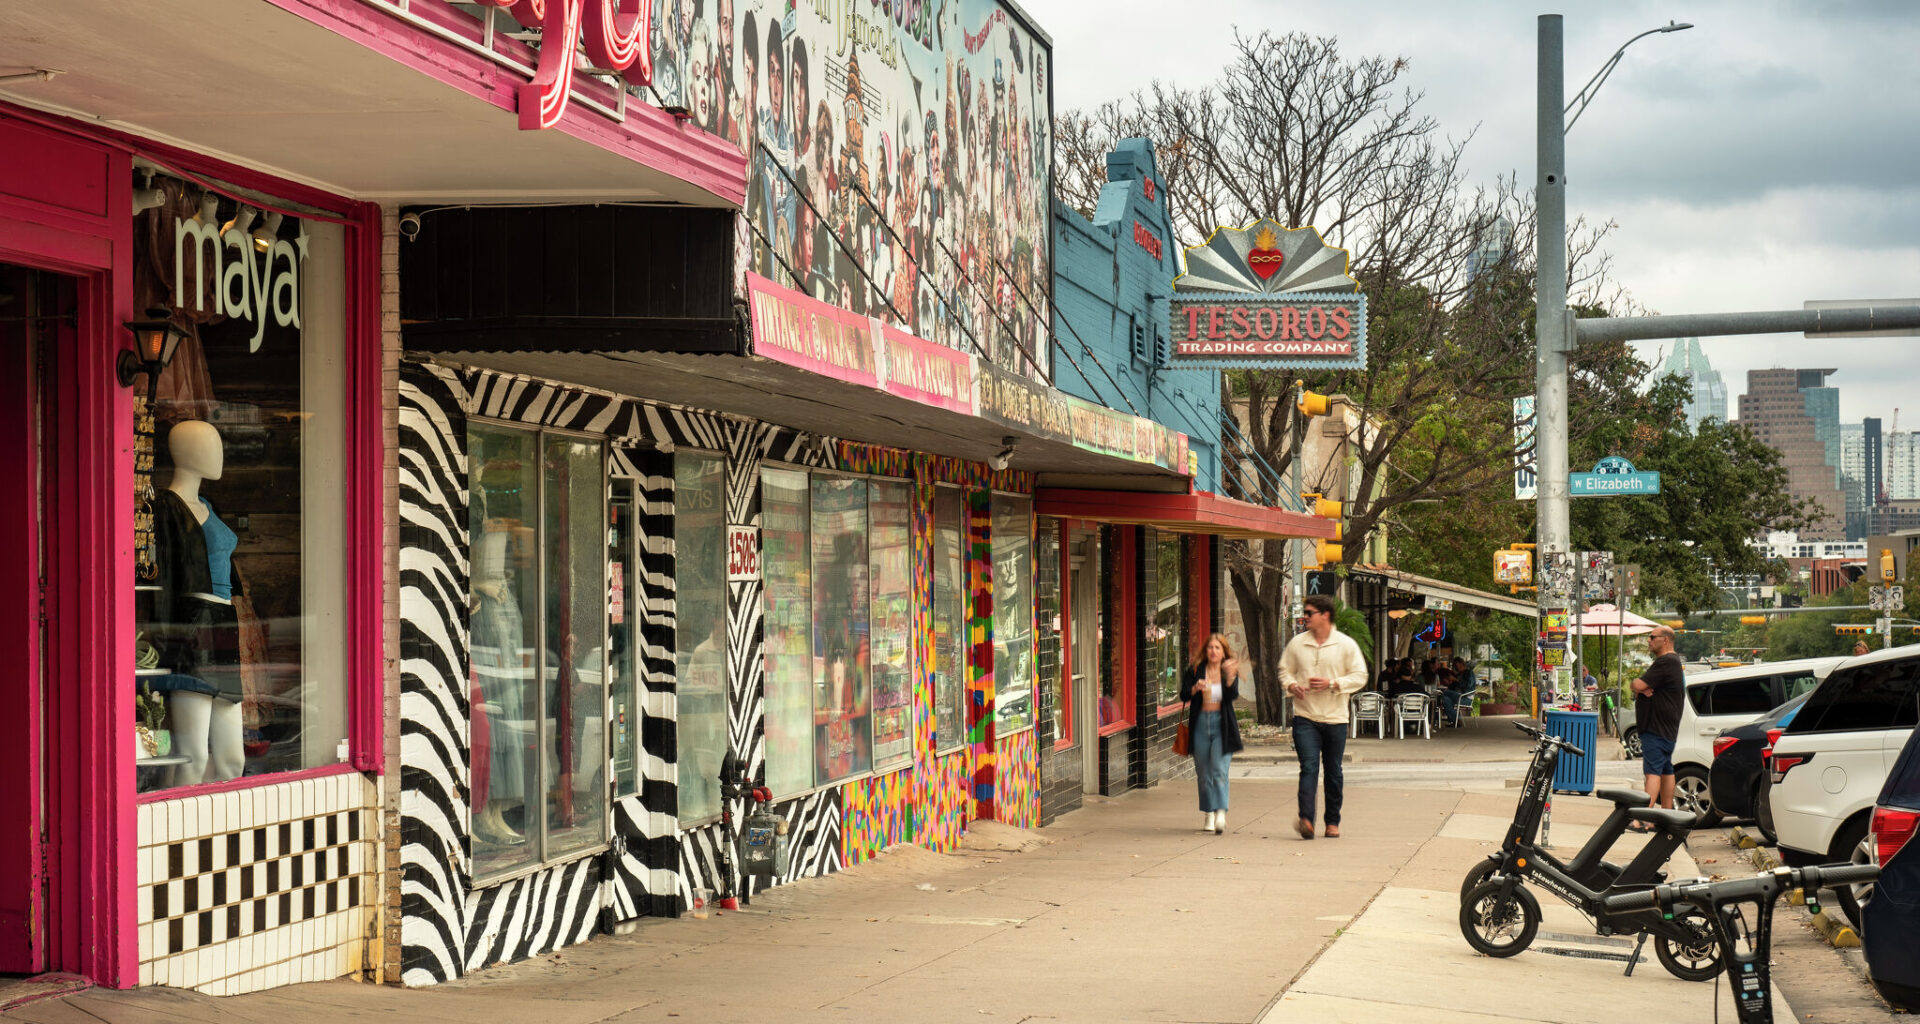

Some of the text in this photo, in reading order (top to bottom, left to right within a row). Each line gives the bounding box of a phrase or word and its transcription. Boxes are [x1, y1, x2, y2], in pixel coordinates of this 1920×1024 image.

[175, 216, 300, 353] maya
[753, 288, 803, 354] VINTAGE
[1181, 306, 1352, 340] TESOROS
[1179, 343, 1349, 353] TRADING COMPANY
[1574, 480, 1583, 488] W
[1586, 477, 1643, 490] Elizabeth
[729, 531, 756, 575] 1506
[1353, 575, 1380, 584] ATM
[1537, 777, 1550, 801] WHEELS
[1531, 869, 1583, 904] takewheels.com
